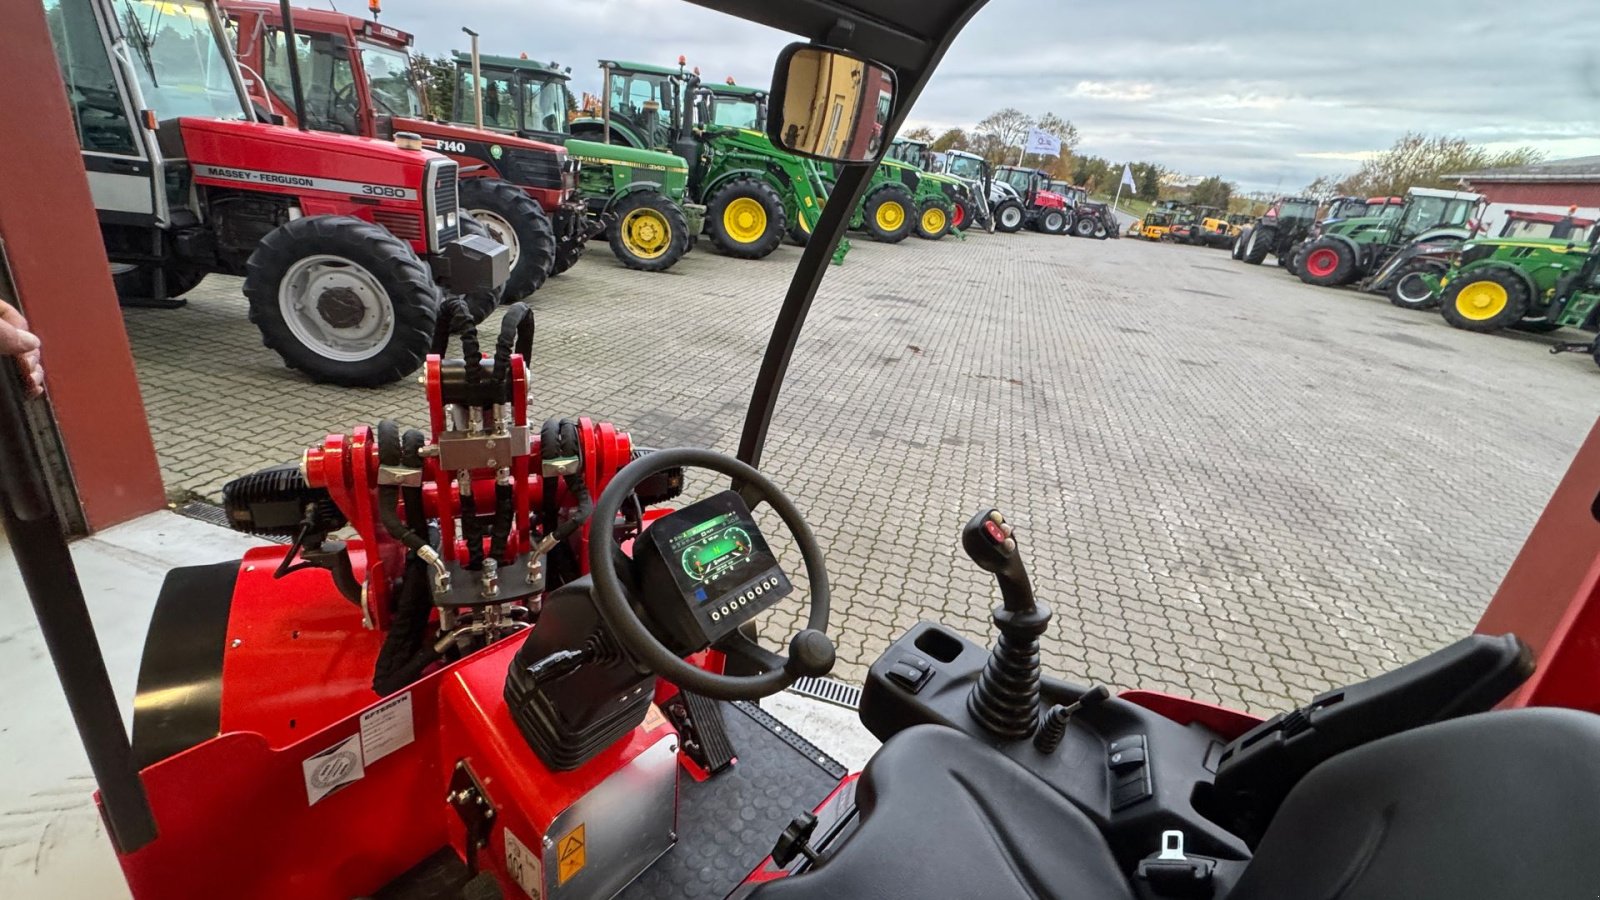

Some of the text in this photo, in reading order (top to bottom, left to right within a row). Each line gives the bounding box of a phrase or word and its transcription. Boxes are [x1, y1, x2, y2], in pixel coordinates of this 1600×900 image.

[436, 140, 466, 153] F140
[208, 167, 250, 180] MASSEY
[260, 173, 313, 187] FERGUSON
[362, 185, 406, 198] 3080
